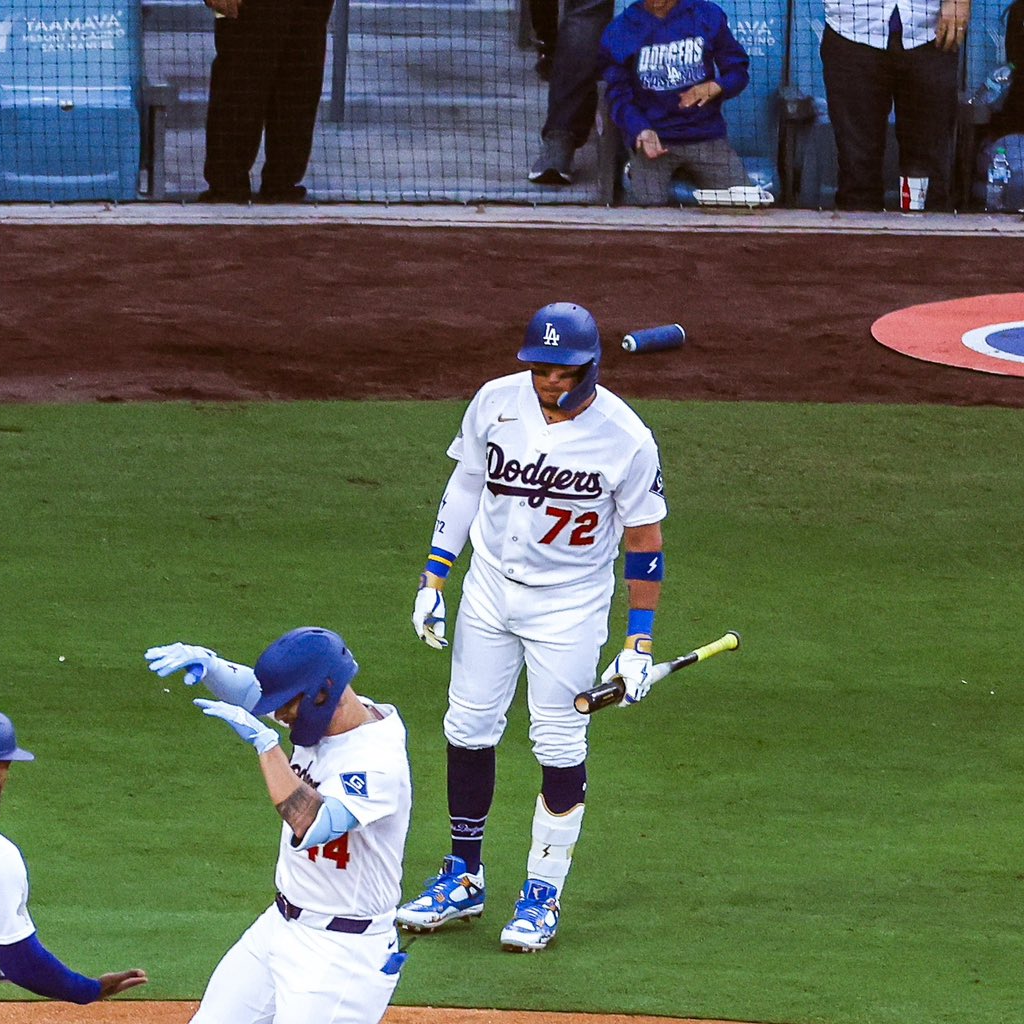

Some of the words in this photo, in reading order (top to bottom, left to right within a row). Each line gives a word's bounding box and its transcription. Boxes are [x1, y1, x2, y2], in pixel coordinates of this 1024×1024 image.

[638, 36, 705, 72] DODGERS
[738, 36, 776, 47] ASINO
[543, 322, 560, 346] LA
[486, 441, 603, 509] Dodgers
[537, 506, 599, 546] 72
